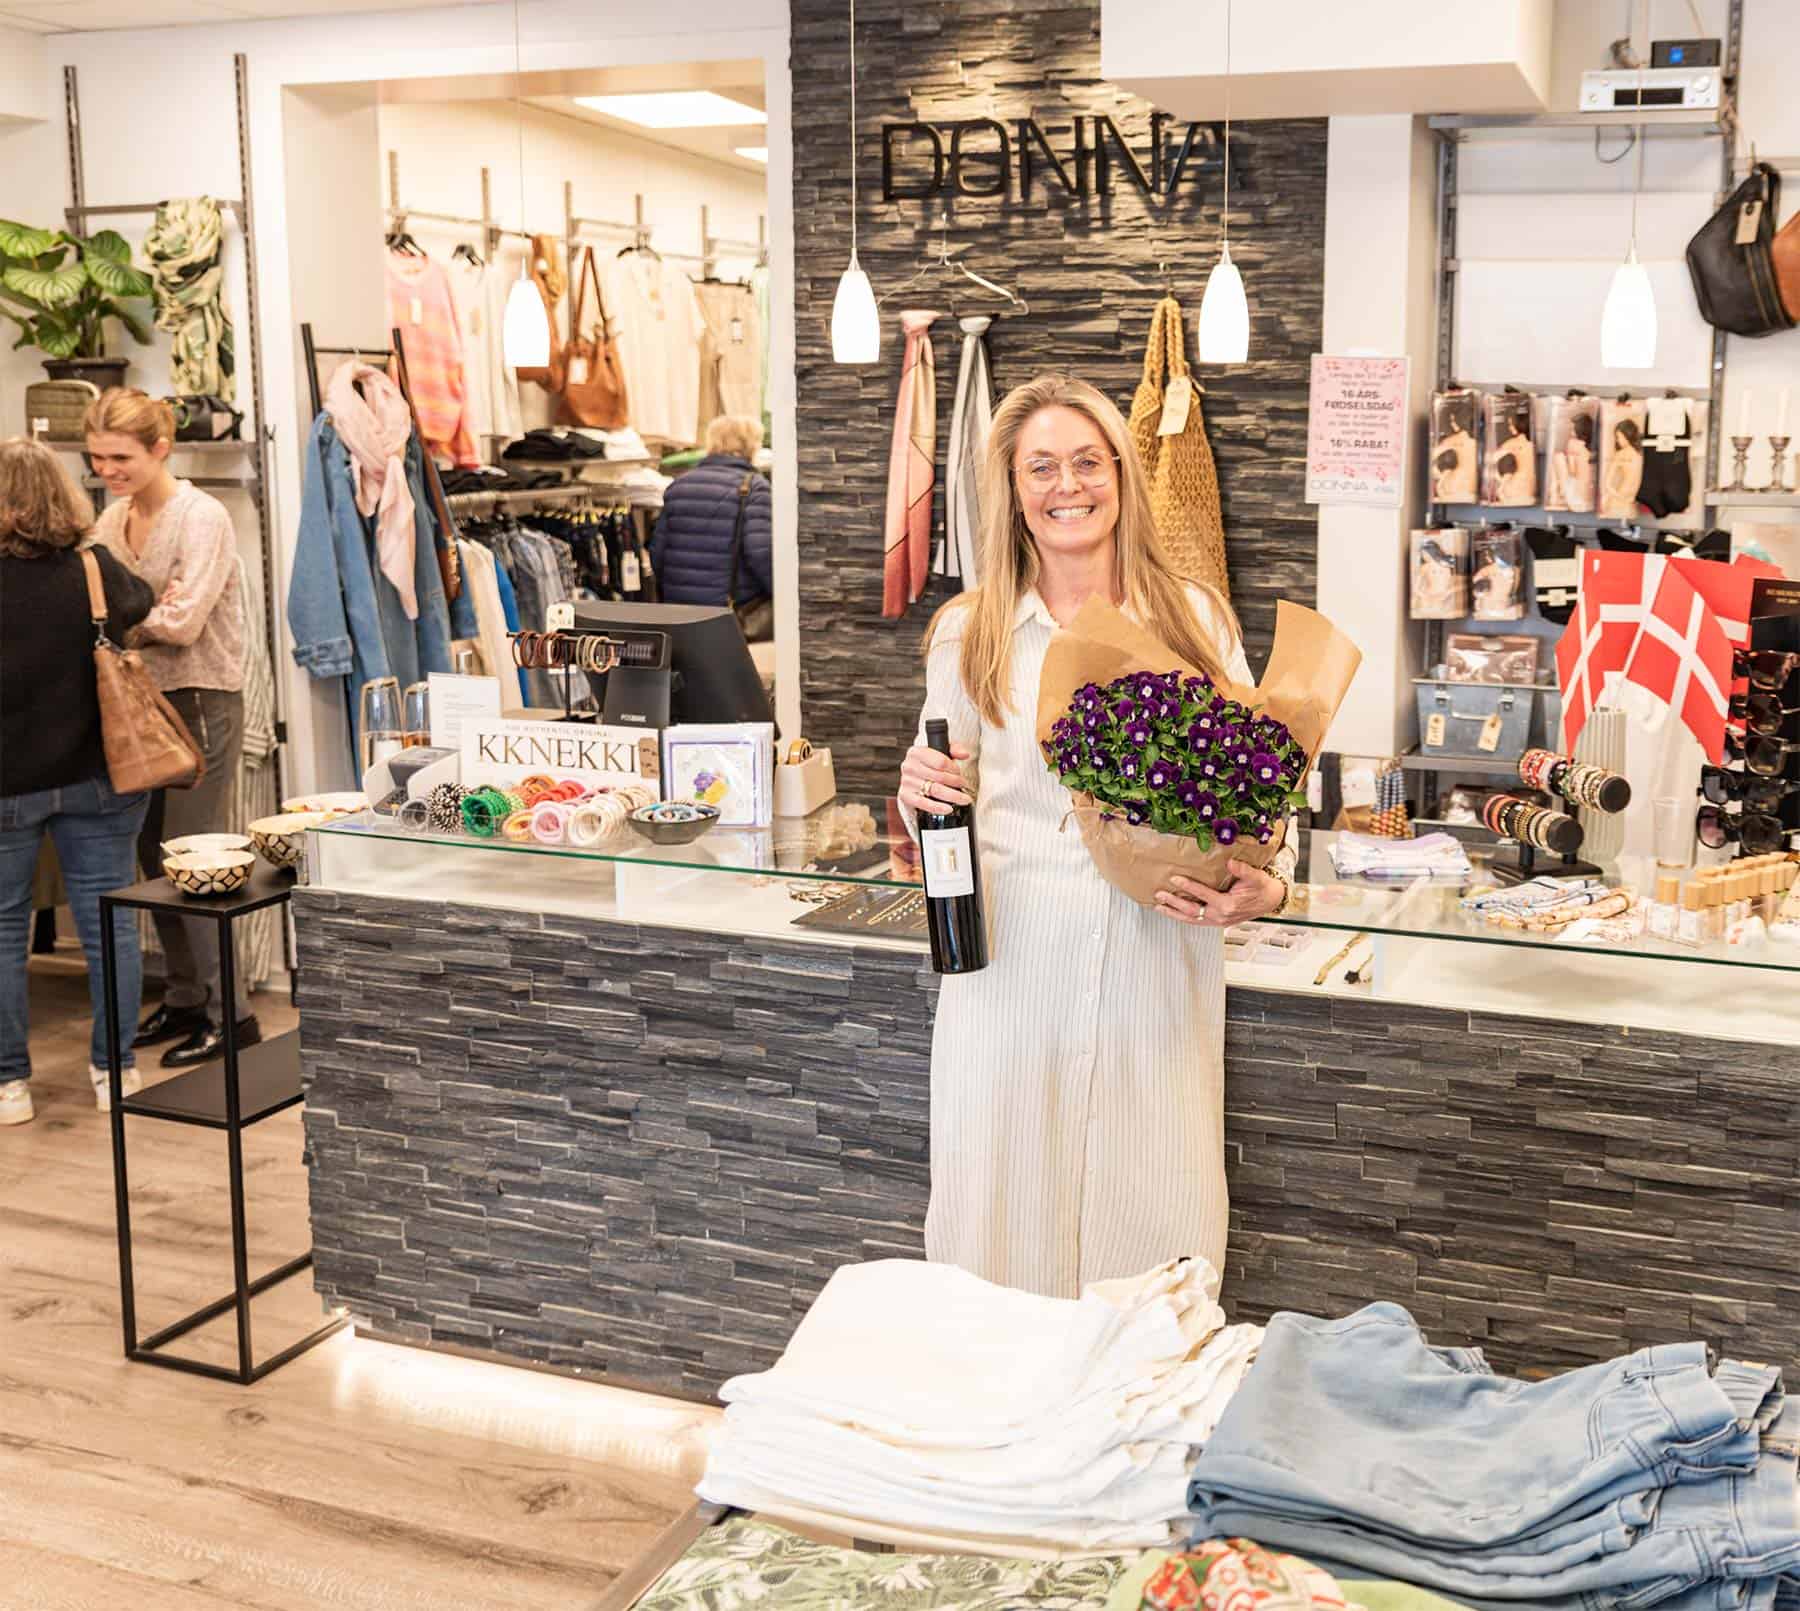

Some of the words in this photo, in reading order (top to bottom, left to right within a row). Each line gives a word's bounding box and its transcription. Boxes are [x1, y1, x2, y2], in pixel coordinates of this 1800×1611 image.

[882, 112, 1226, 200] DONNA
[1354, 439, 1390, 449] RABAT
[478, 733, 639, 774] KKNEKKI
